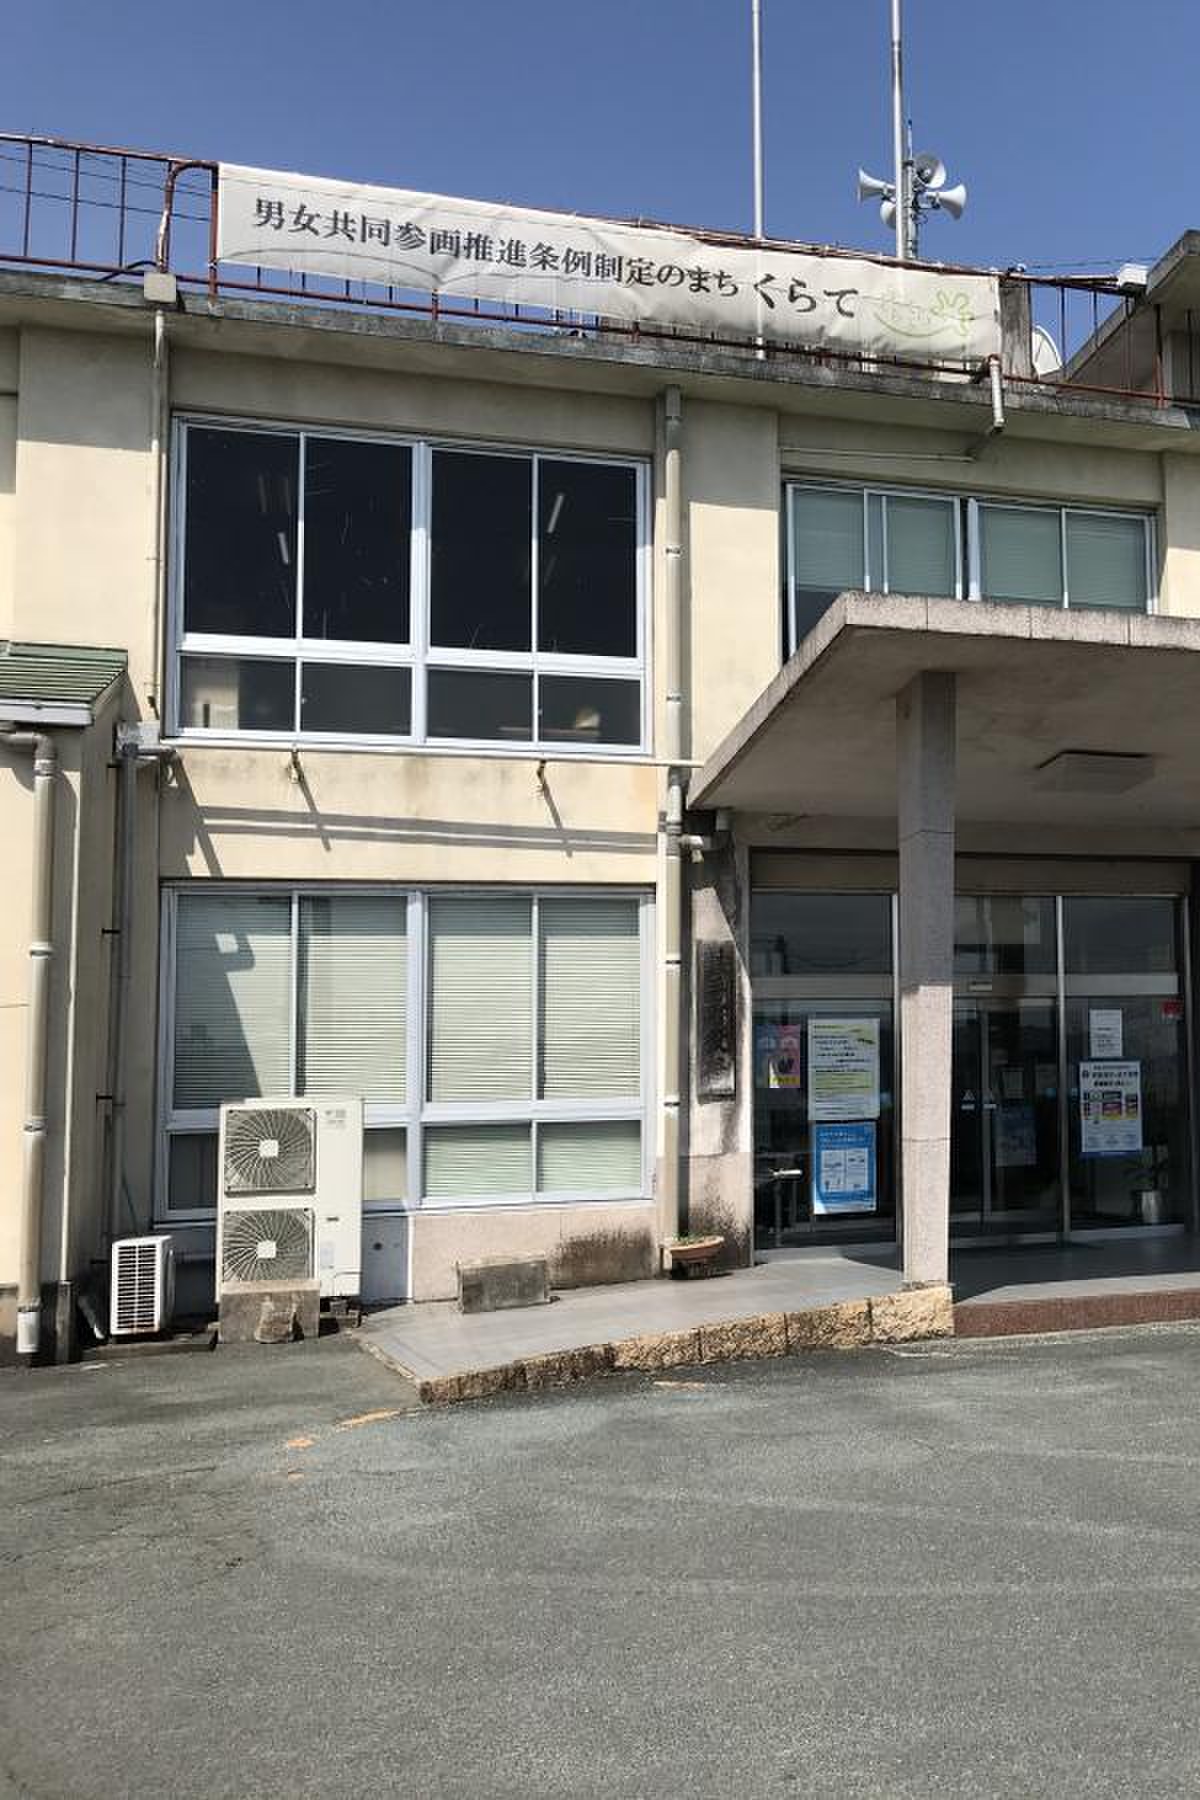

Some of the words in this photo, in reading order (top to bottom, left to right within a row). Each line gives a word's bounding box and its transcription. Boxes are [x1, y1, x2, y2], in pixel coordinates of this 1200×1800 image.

[253, 197, 740, 297] 男女共同参画推進条例制定のまち
[753, 273, 859, 318] くらて
